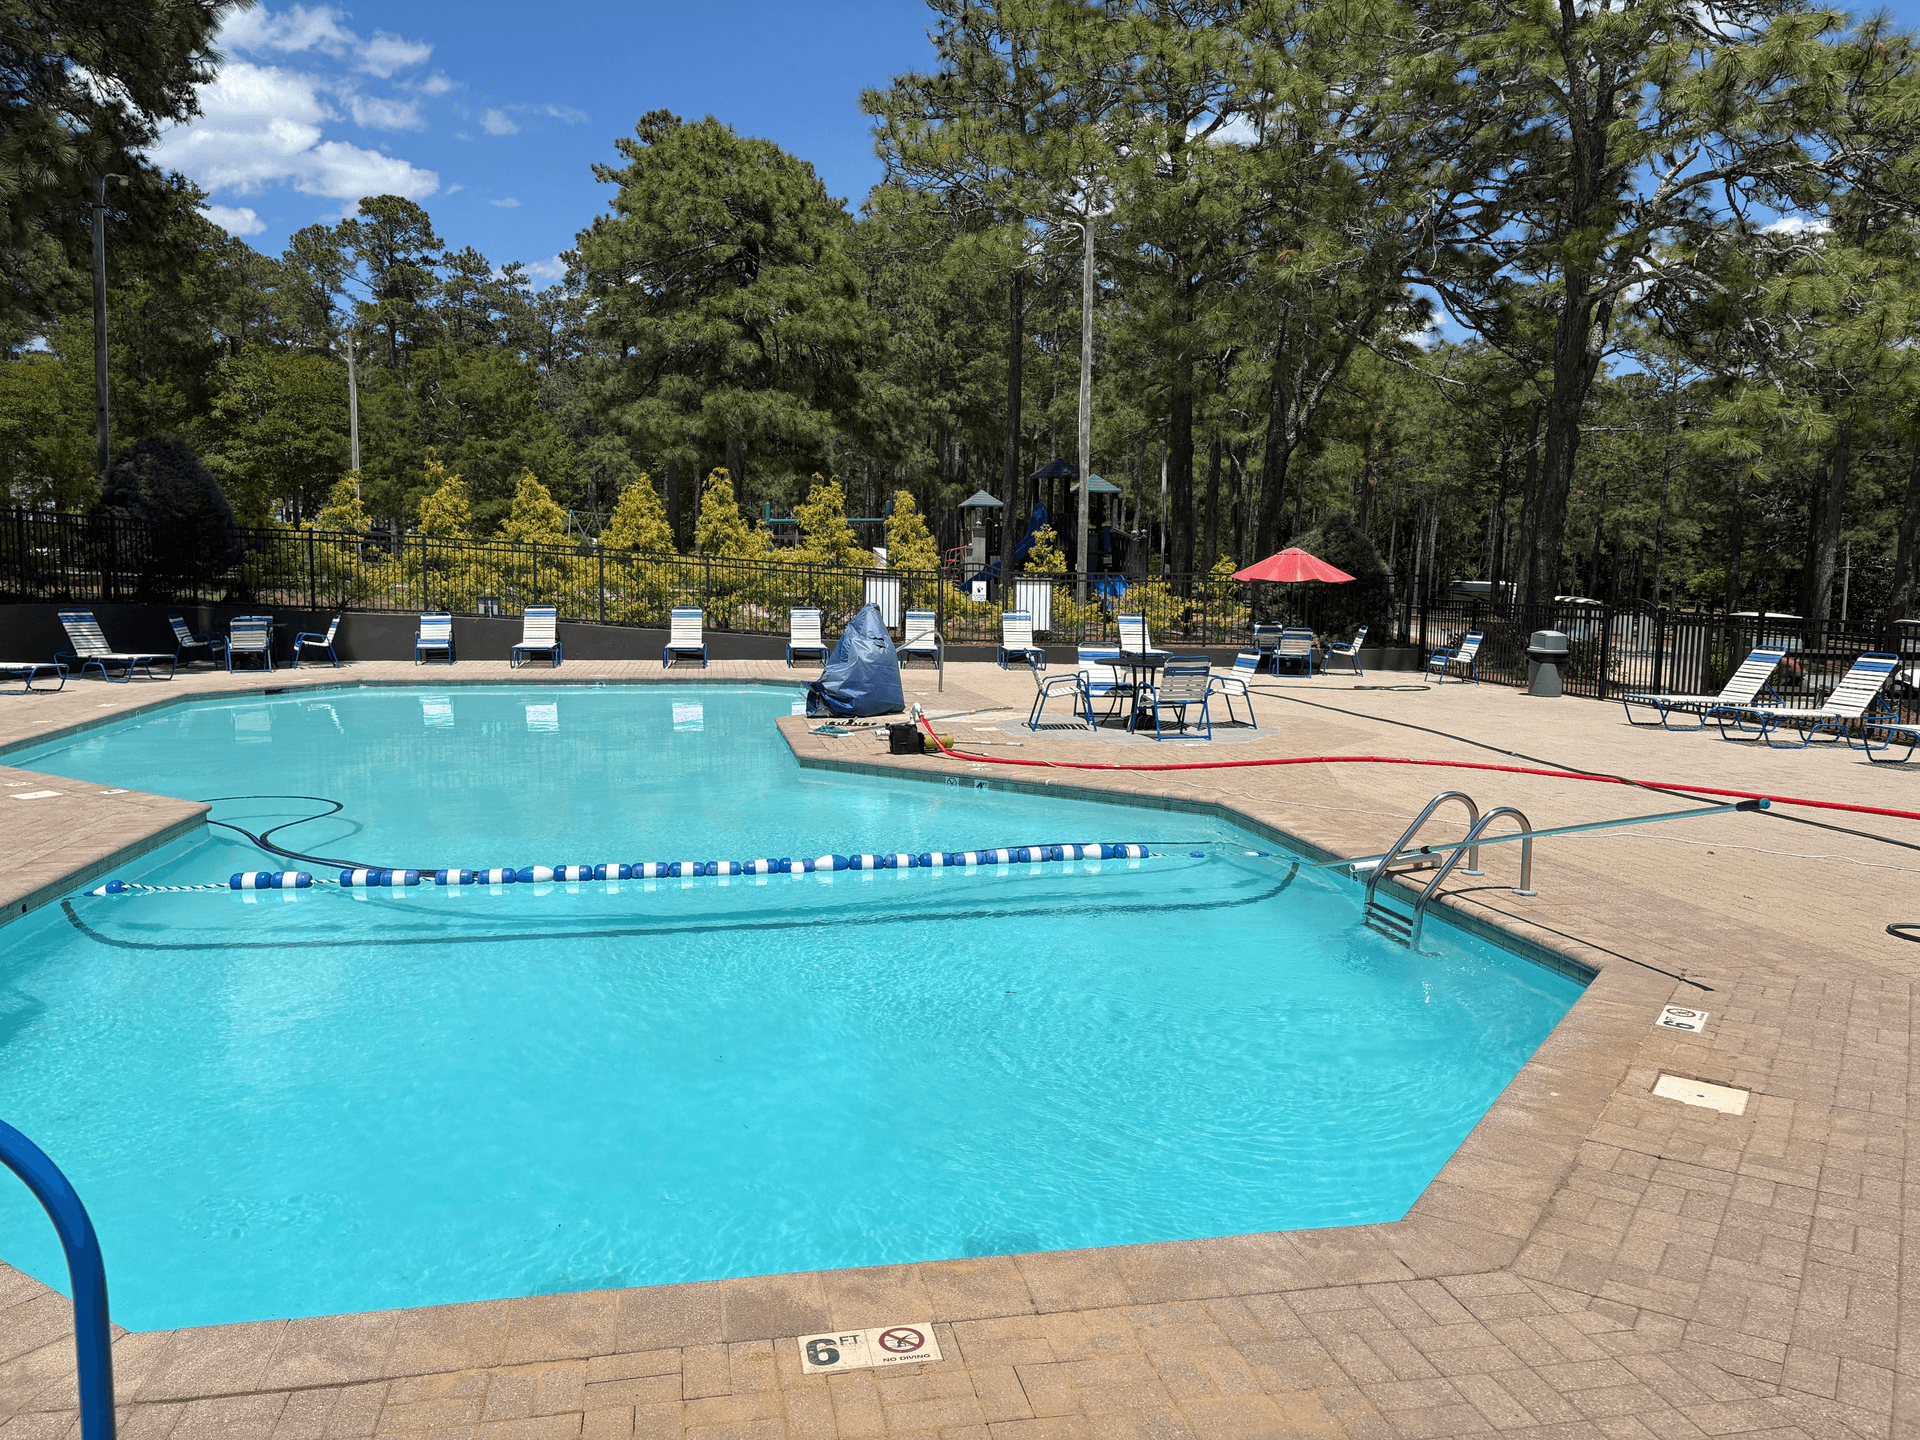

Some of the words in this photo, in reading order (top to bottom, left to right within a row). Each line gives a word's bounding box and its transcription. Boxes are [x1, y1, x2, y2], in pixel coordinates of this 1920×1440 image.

[1663, 1020, 1695, 1029] 6
[806, 1339, 840, 1366] 6
[839, 1335, 860, 1346] FT
[899, 1353, 931, 1361] DIVING
